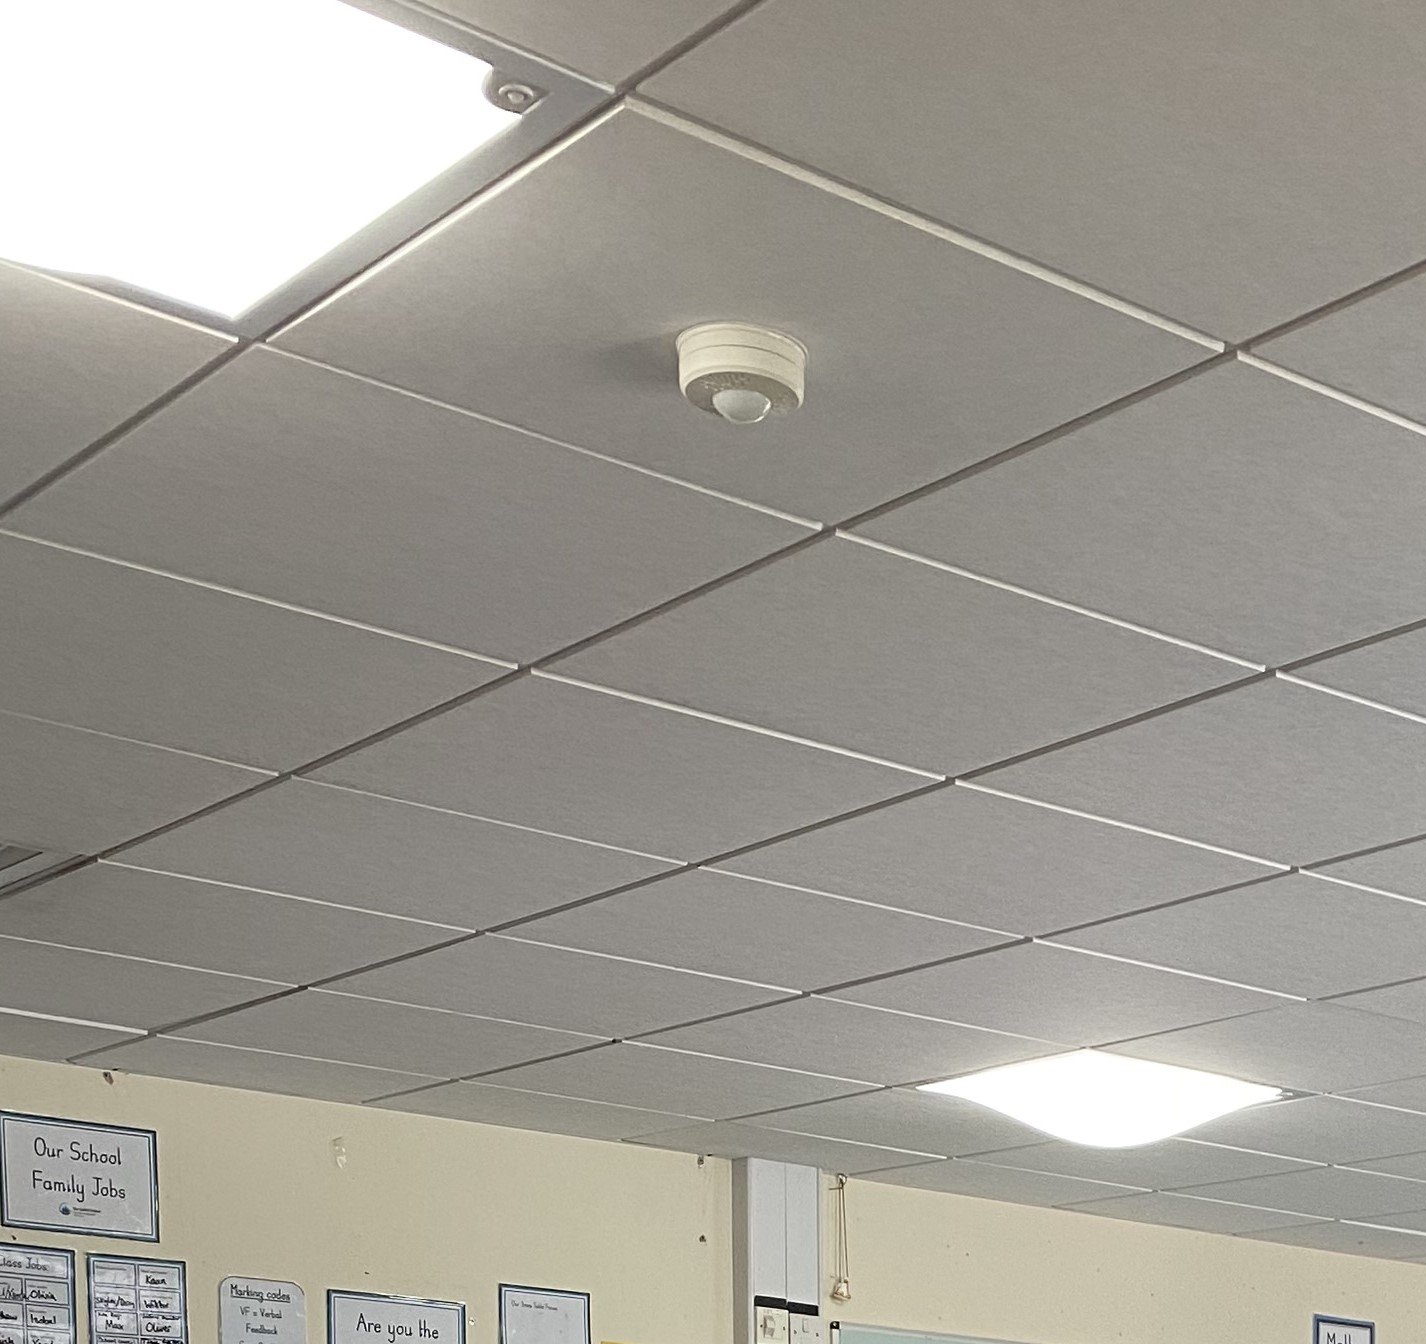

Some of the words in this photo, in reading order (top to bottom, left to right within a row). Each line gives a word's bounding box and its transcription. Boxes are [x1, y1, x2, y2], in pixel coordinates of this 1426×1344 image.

[34, 1137, 63, 1158] Our
[70, 1142, 121, 1165] School
[32, 1170, 84, 1202] Family
[92, 1177, 125, 1198] Jobs
[0, 1258, 21, 1269] lass
[26, 1257, 47, 1271] Jobs
[230, 1284, 263, 1302] Marking
[266, 1289, 290, 1301] codes
[240, 1306, 250, 1316] VF
[260, 1308, 282, 1319] Verbal
[246, 1323, 278, 1335] Feedback
[356, 1313, 381, 1333] Are
[388, 1322, 413, 1343] you
[419, 1320, 439, 1339] the
